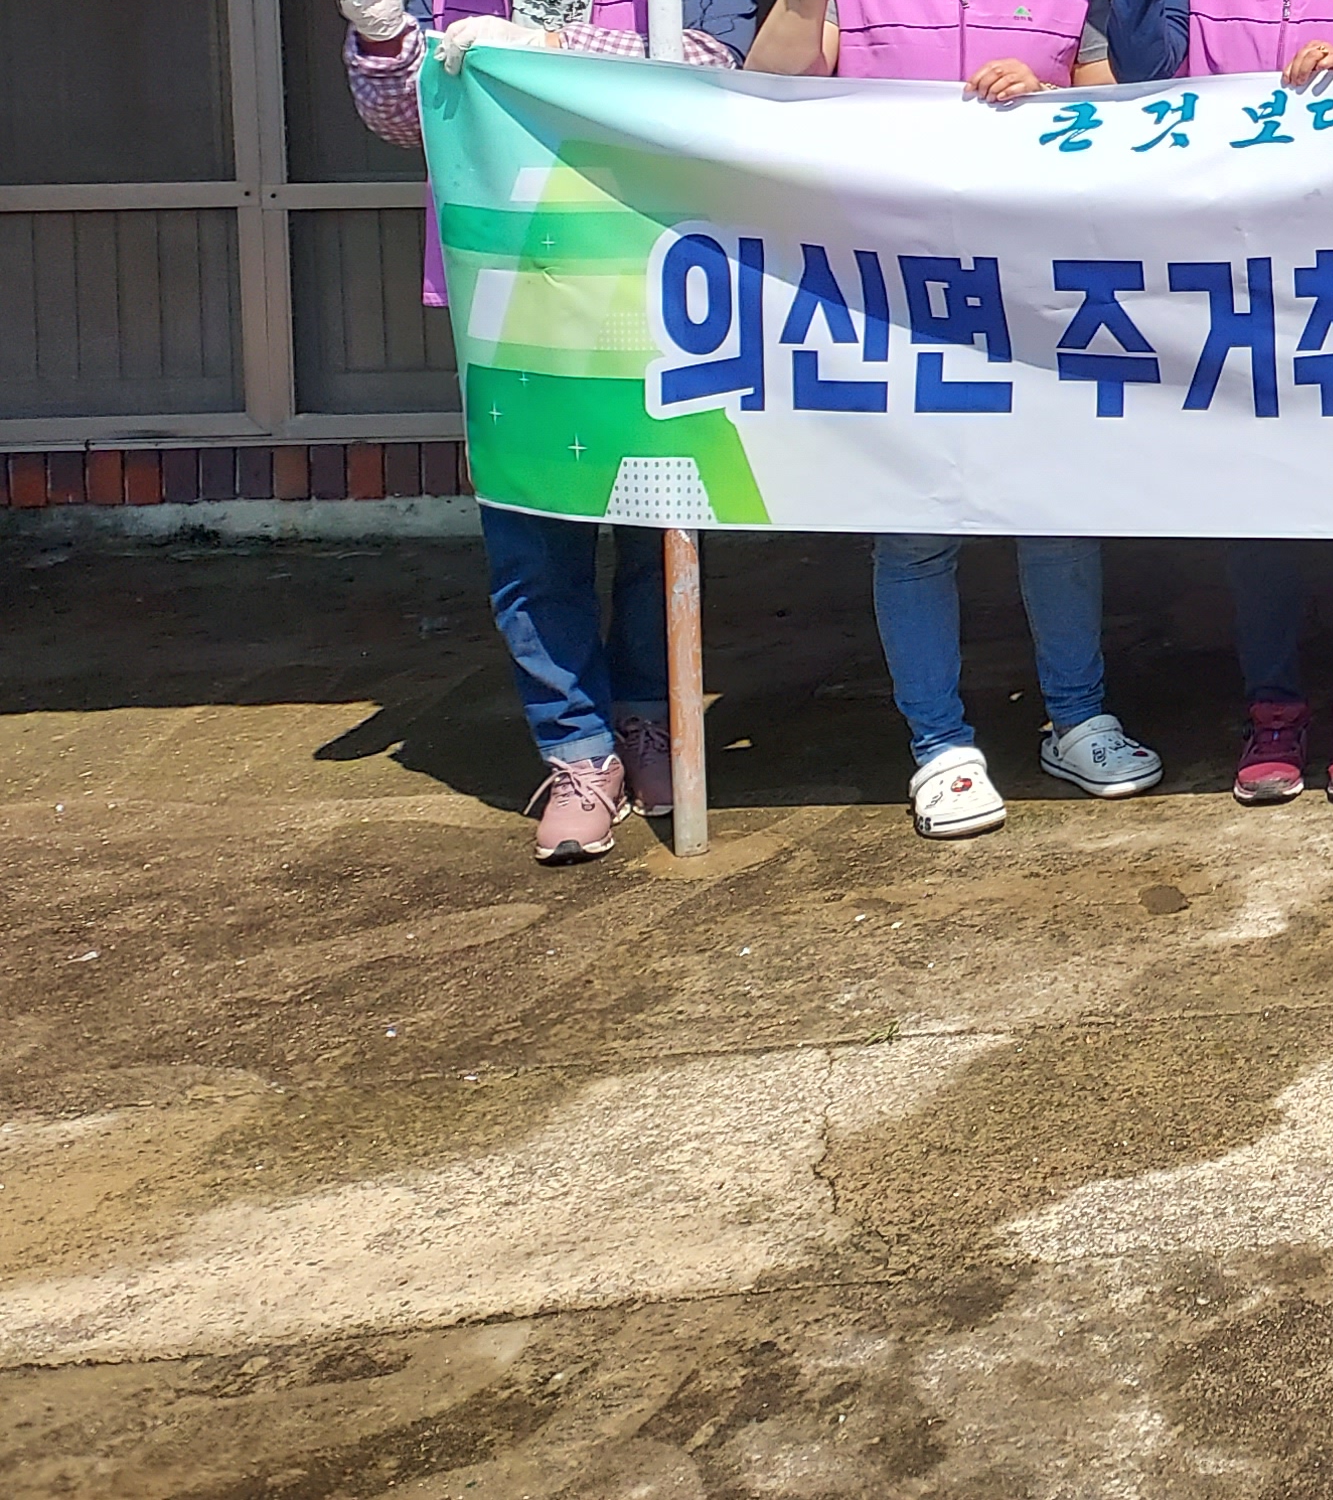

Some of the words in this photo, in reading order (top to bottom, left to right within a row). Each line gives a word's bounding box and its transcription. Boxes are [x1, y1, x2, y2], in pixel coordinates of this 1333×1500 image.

[1039, 98, 1104, 153] 큰
[1132, 91, 1201, 153] 것
[660, 233, 1014, 414] 의신면
